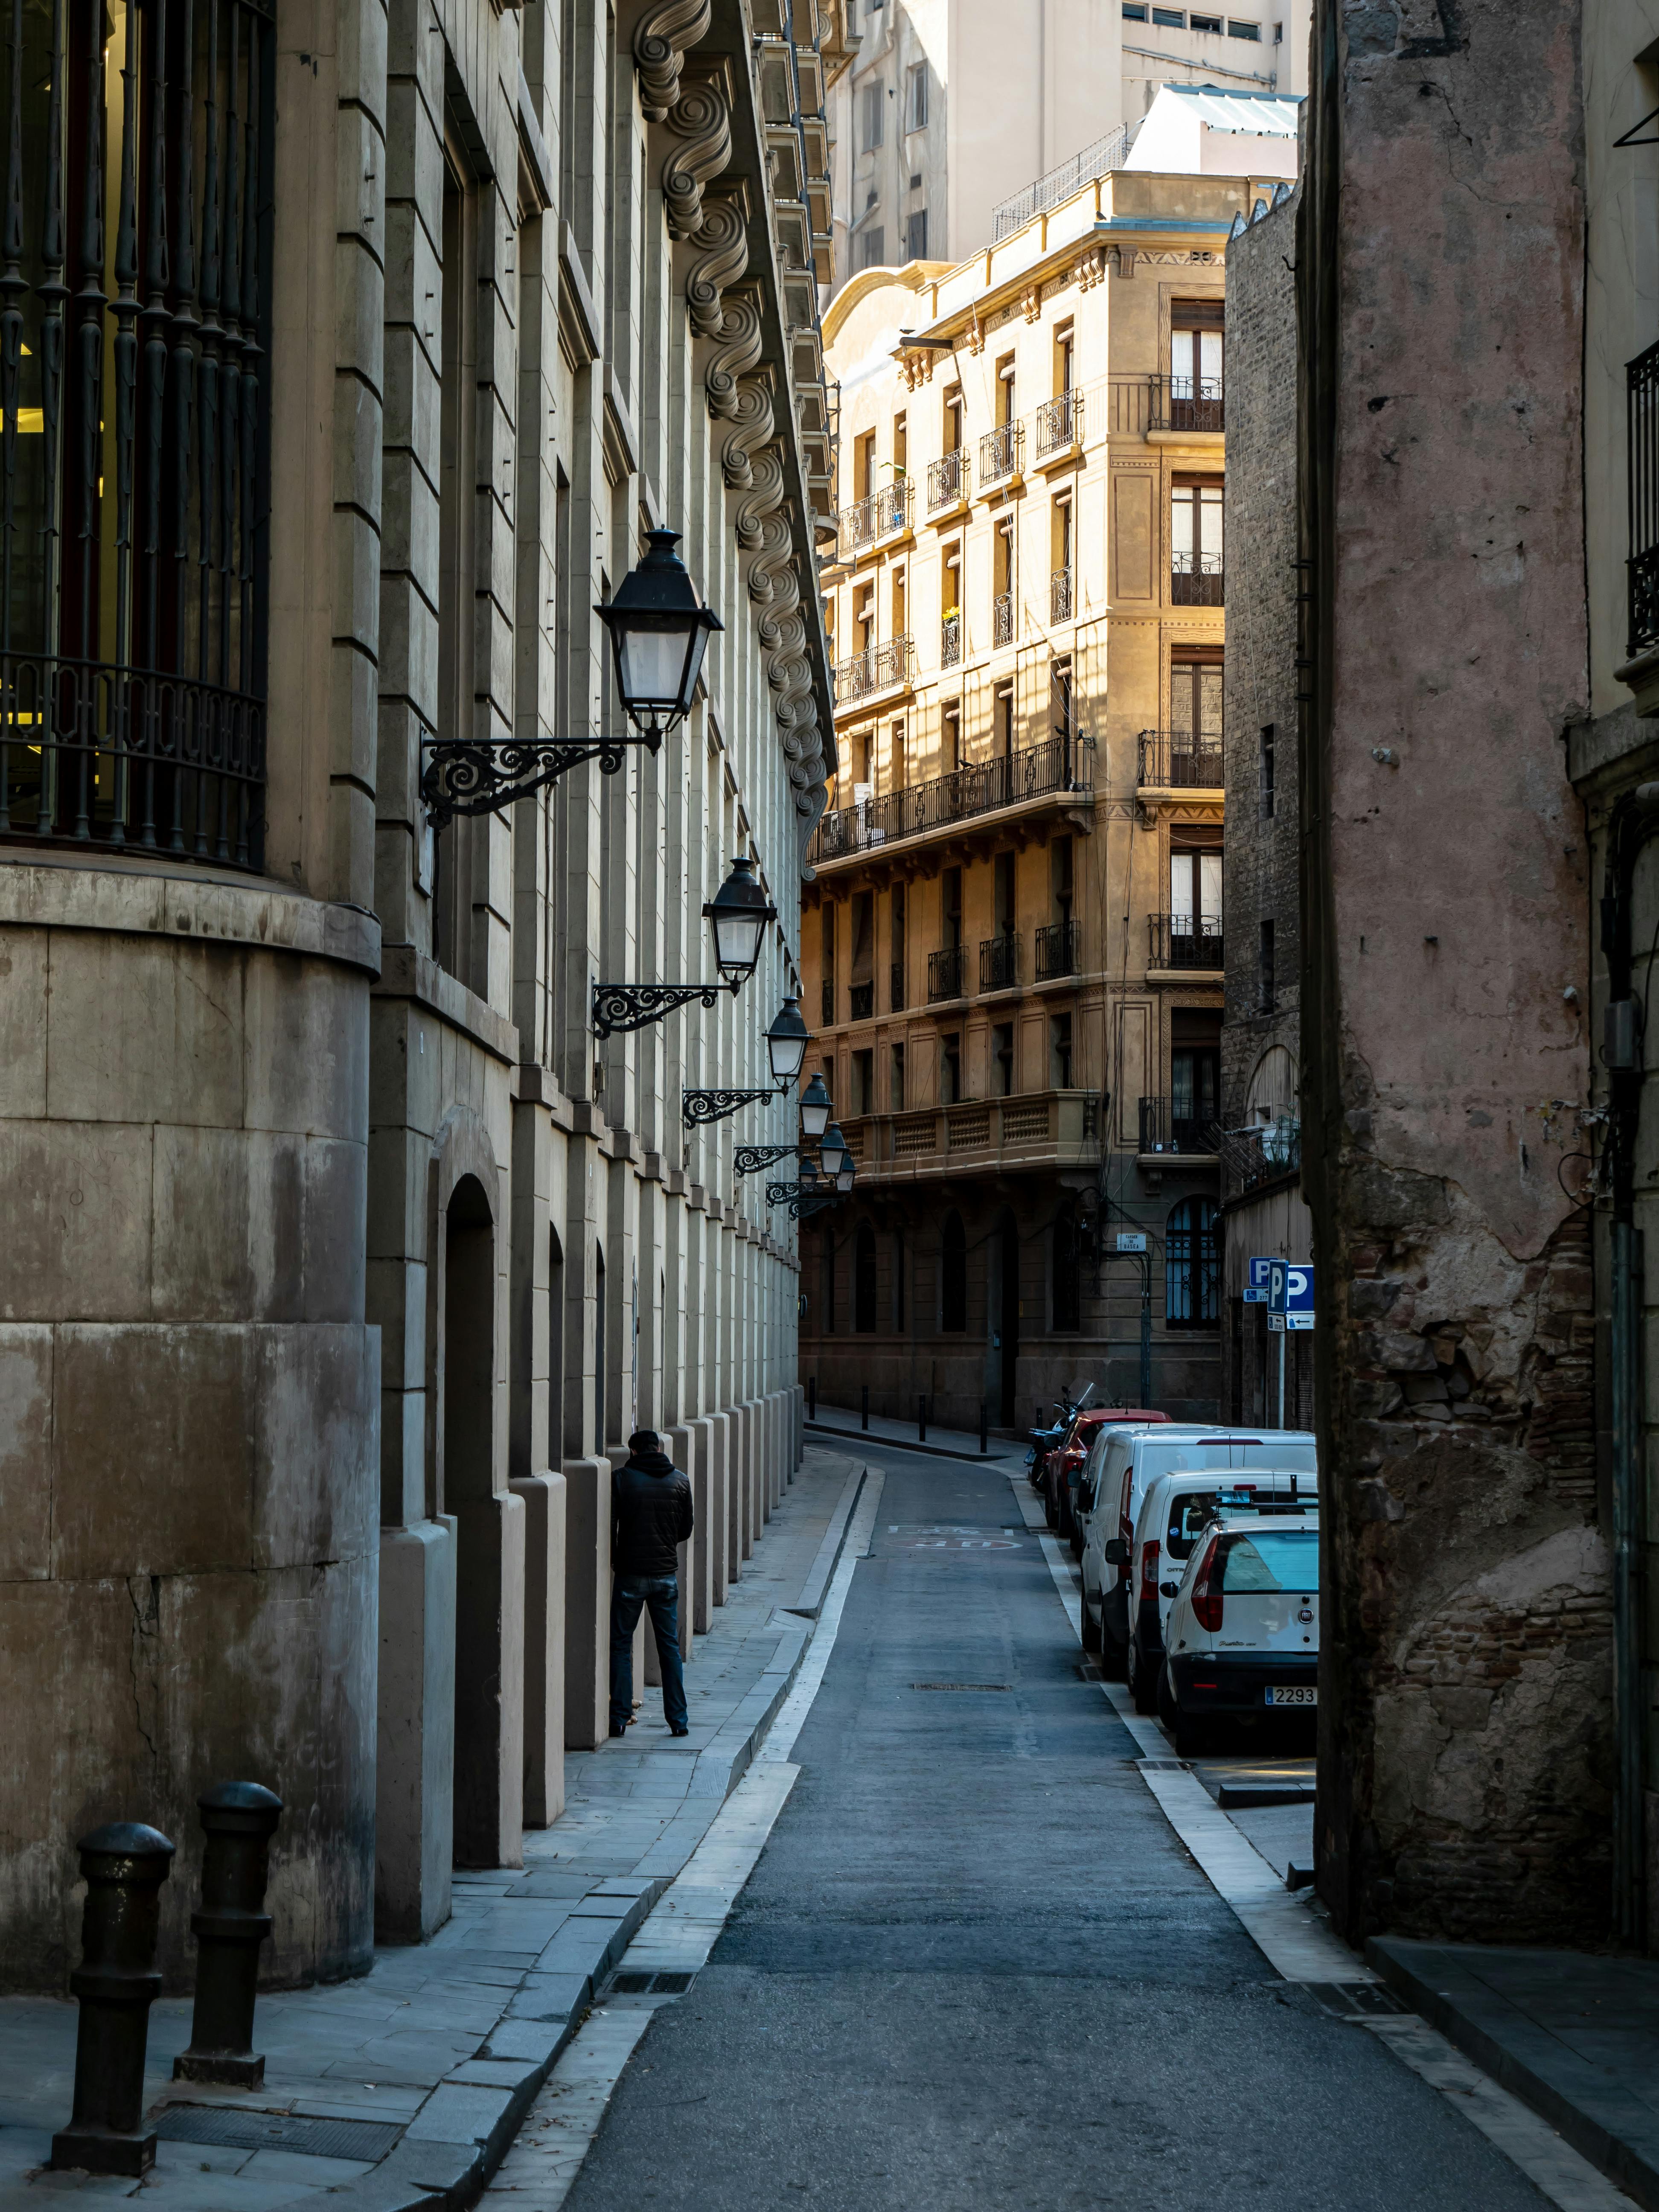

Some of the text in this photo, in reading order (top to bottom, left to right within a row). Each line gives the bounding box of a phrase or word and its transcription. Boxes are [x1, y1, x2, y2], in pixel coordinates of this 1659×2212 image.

[1255, 1260, 1269, 1284] P
[1271, 1267, 1283, 1308] P
[1287, 1271, 1307, 1308] P
[1276, 1688, 1314, 1703] 2293
